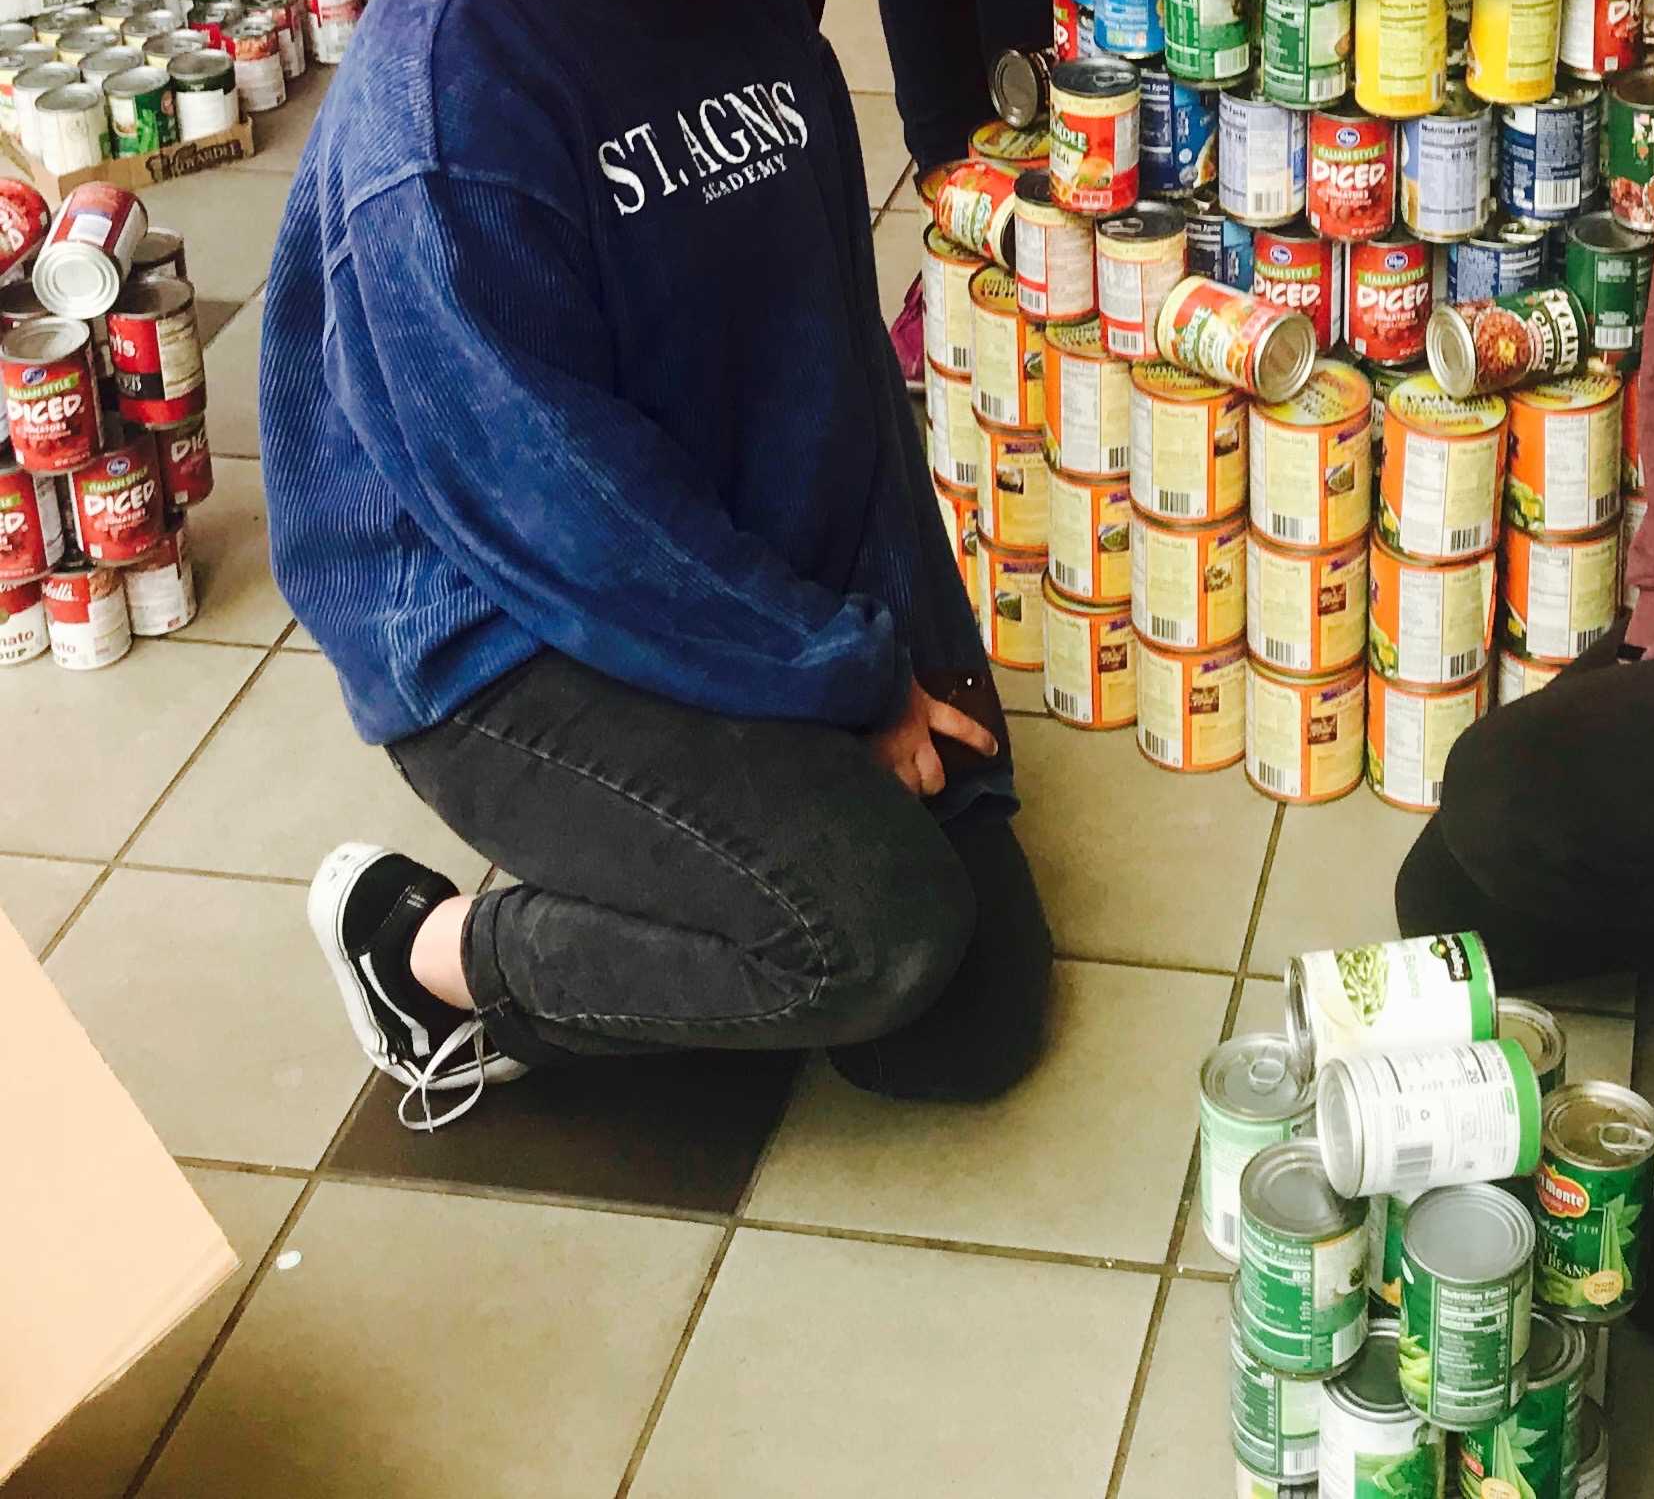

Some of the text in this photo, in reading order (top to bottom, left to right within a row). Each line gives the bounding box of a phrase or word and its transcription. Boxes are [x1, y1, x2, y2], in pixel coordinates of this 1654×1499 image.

[702, 153, 788, 205] ACADEMY
[1312, 158, 1386, 189] DICED
[1254, 275, 1321, 307] DICED
[1356, 282, 1430, 313] DICED
[7, 393, 82, 424] DICED
[83, 479, 156, 517] DICED
[1545, 1175, 1586, 1209] Monte
